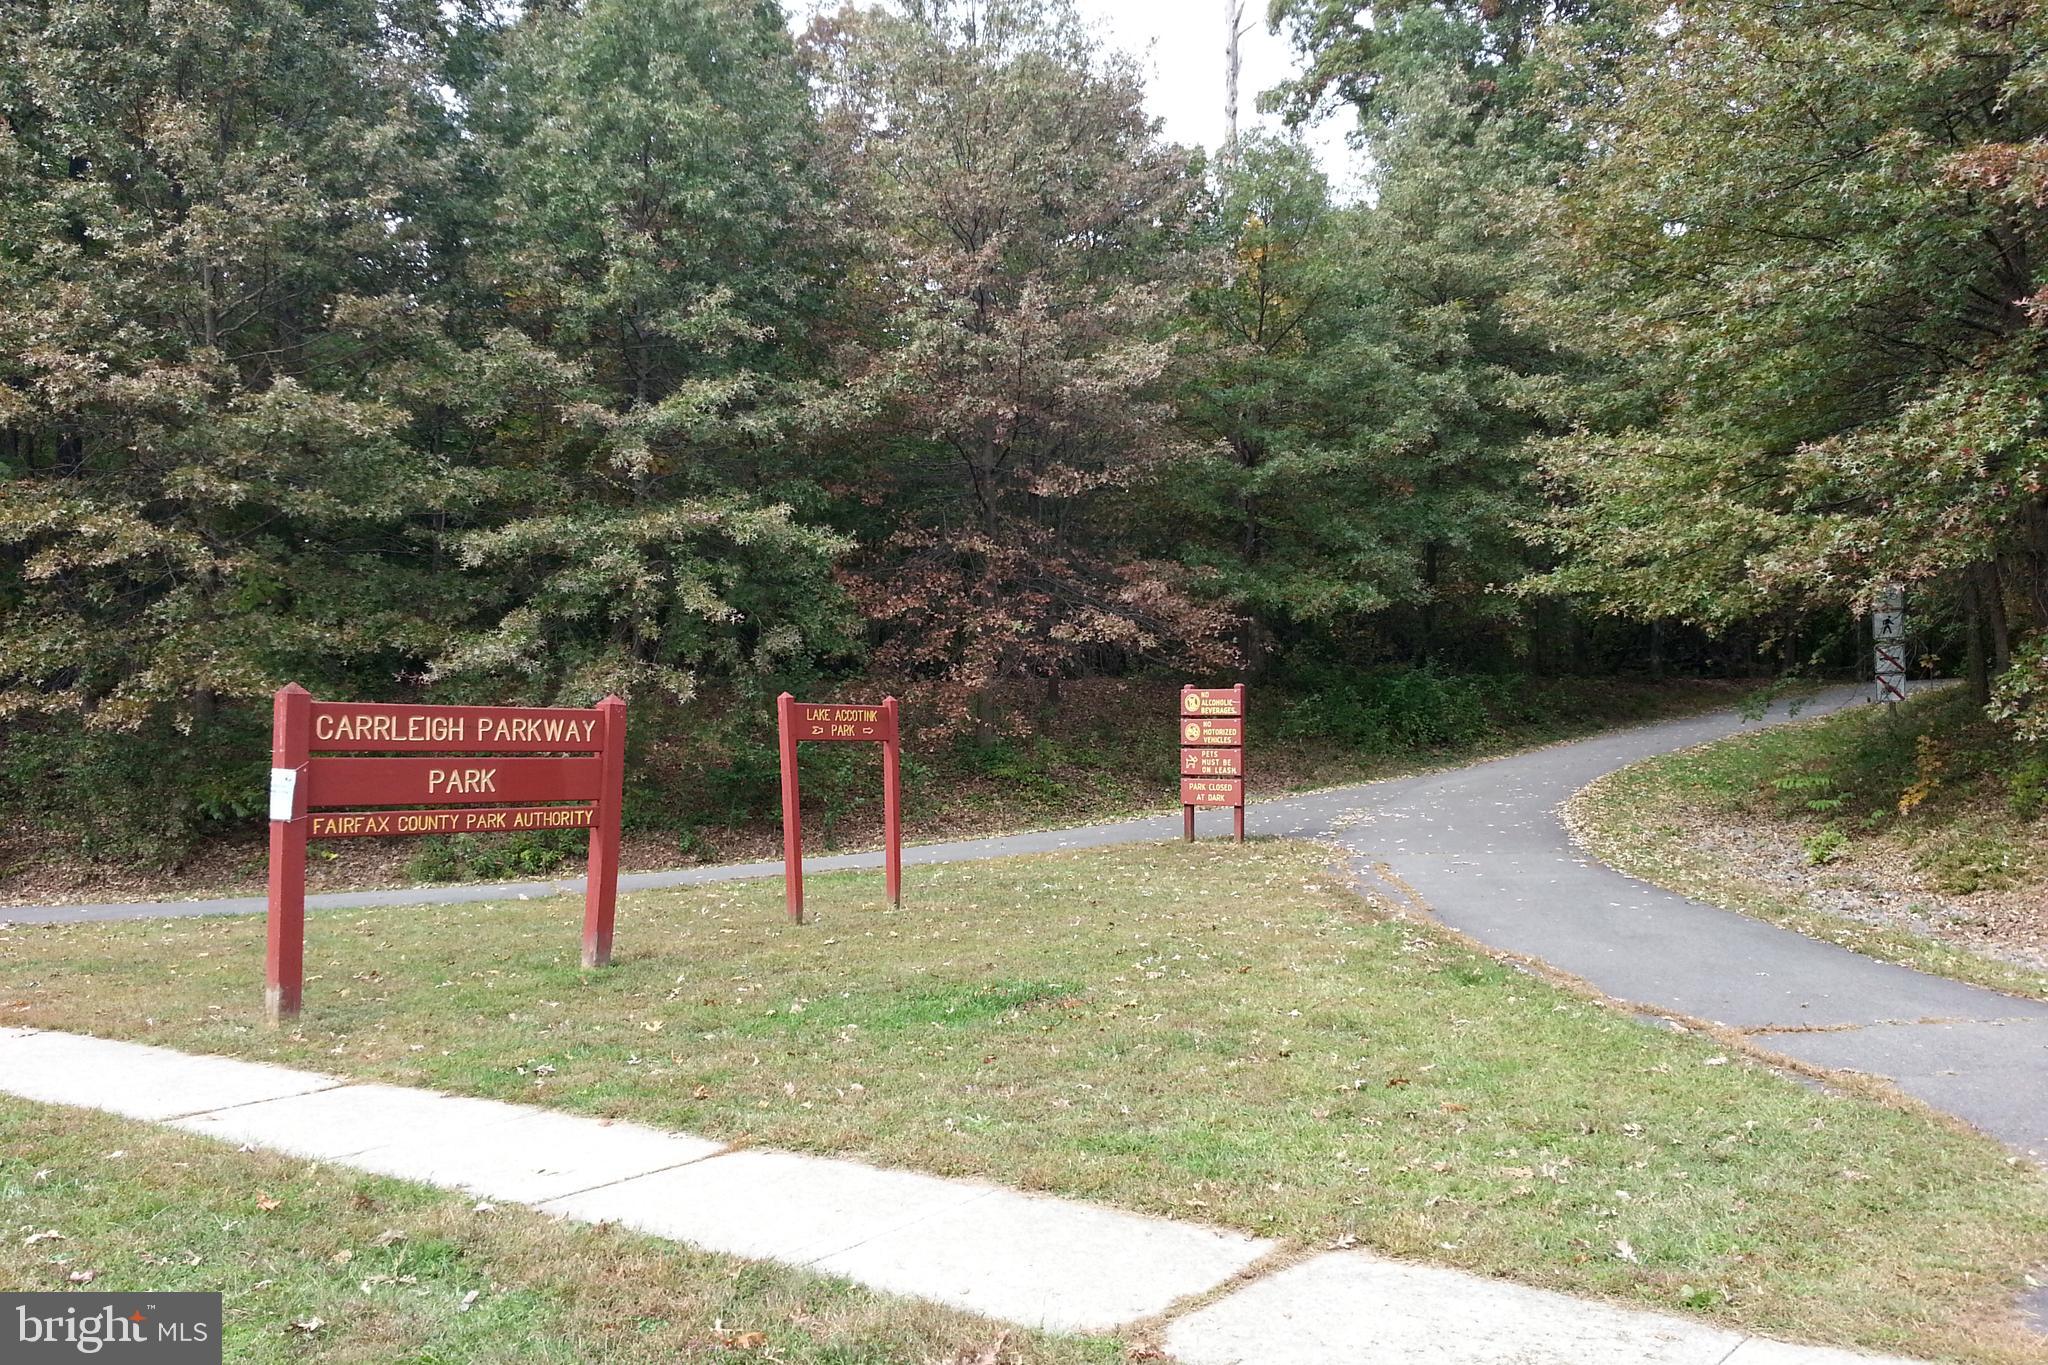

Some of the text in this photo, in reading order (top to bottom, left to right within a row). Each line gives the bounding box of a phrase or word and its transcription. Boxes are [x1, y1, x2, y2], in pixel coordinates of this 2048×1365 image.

[806, 708, 878, 722] LAKE ACCOTINK
[316, 715, 596, 743] CARRLEIGH PARKWAY
[831, 724, 855, 736] PARK
[1201, 758, 1220, 766] MUST
[428, 768, 497, 794] PARK
[1188, 783, 1233, 791] PARK CLOSED
[1196, 793, 1225, 802] AT DARK
[313, 809, 594, 835] FAIRFAX COUNTY PARK AUTHORITY
